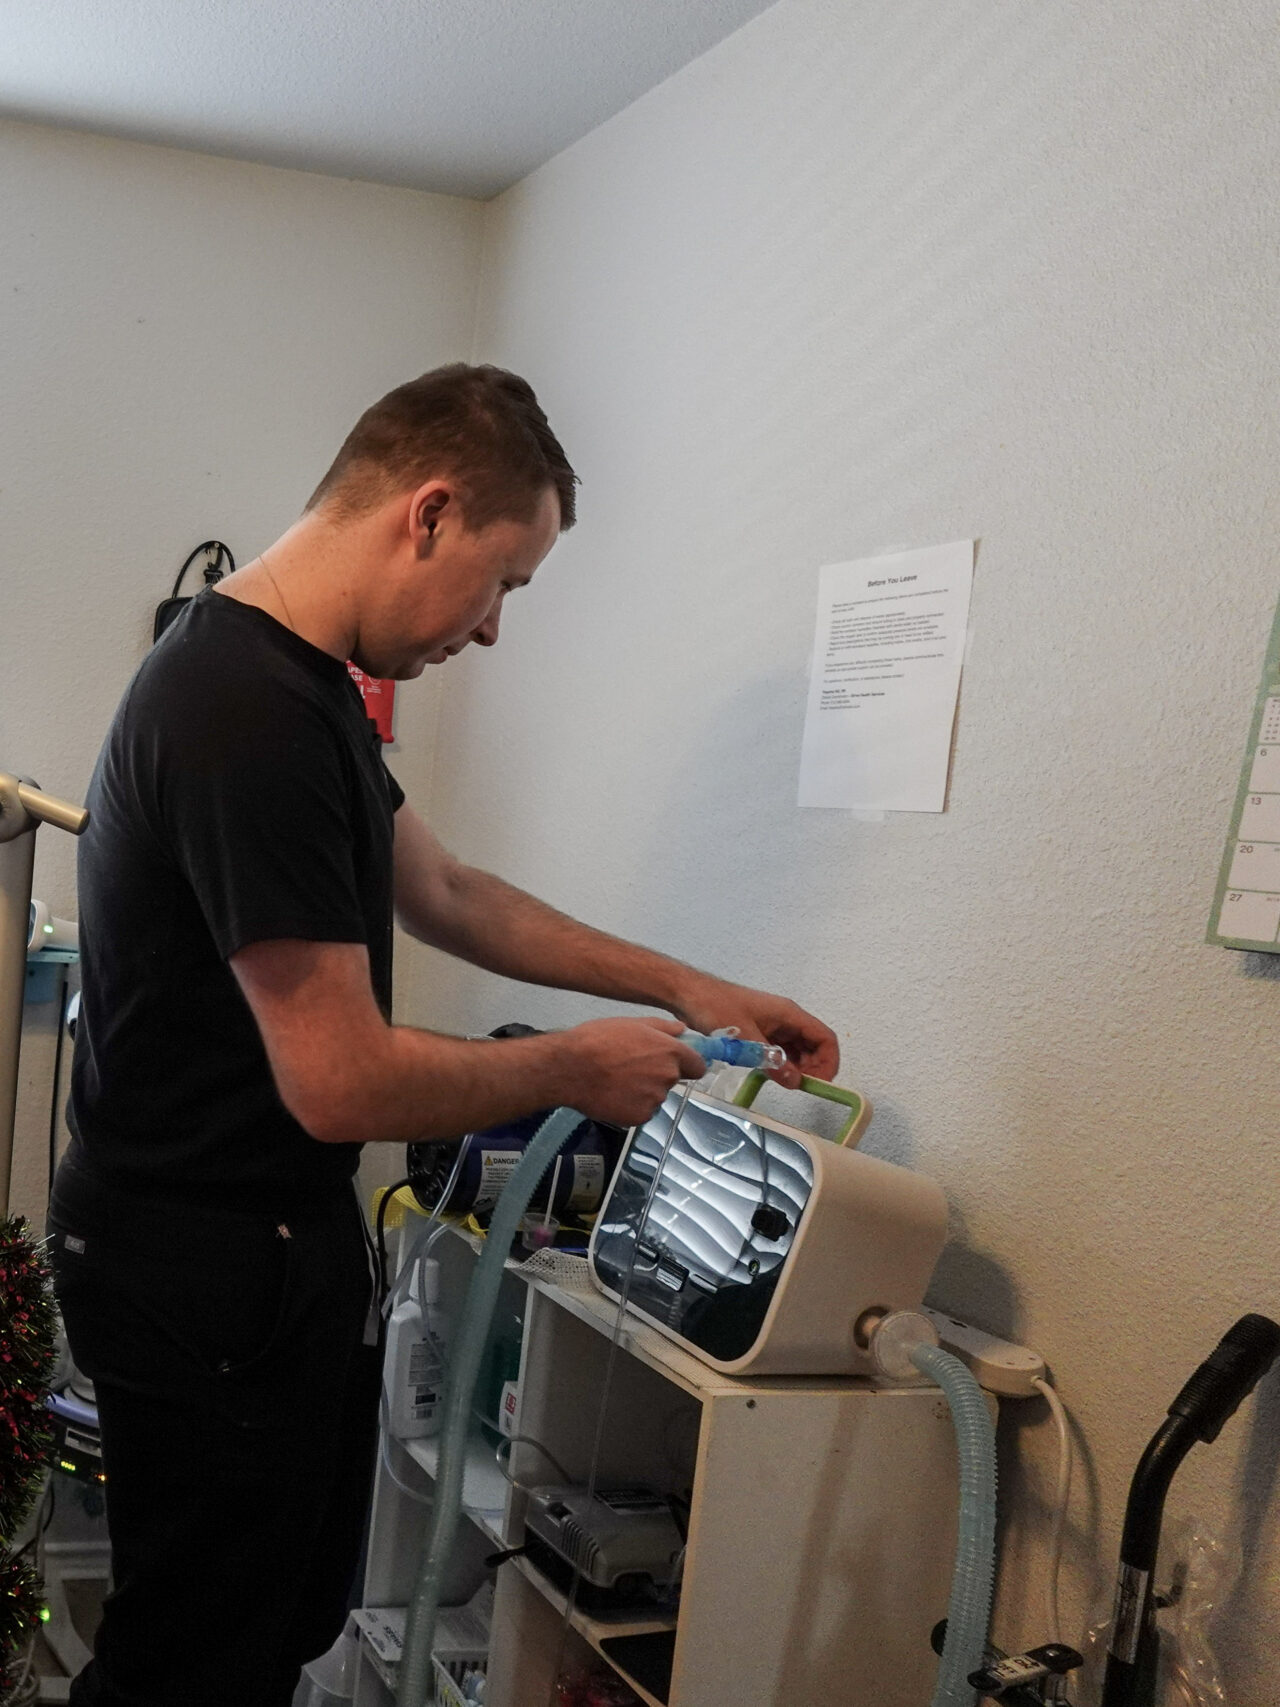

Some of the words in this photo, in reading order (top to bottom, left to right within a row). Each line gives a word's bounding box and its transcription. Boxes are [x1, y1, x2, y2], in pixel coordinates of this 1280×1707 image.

[867, 579, 886, 588] Before
[900, 575, 918, 583] Leave
[1260, 748, 1267, 757] 6
[1251, 797, 1262, 806] 13
[1239, 845, 1254, 854] 20
[1229, 893, 1243, 902] 27
